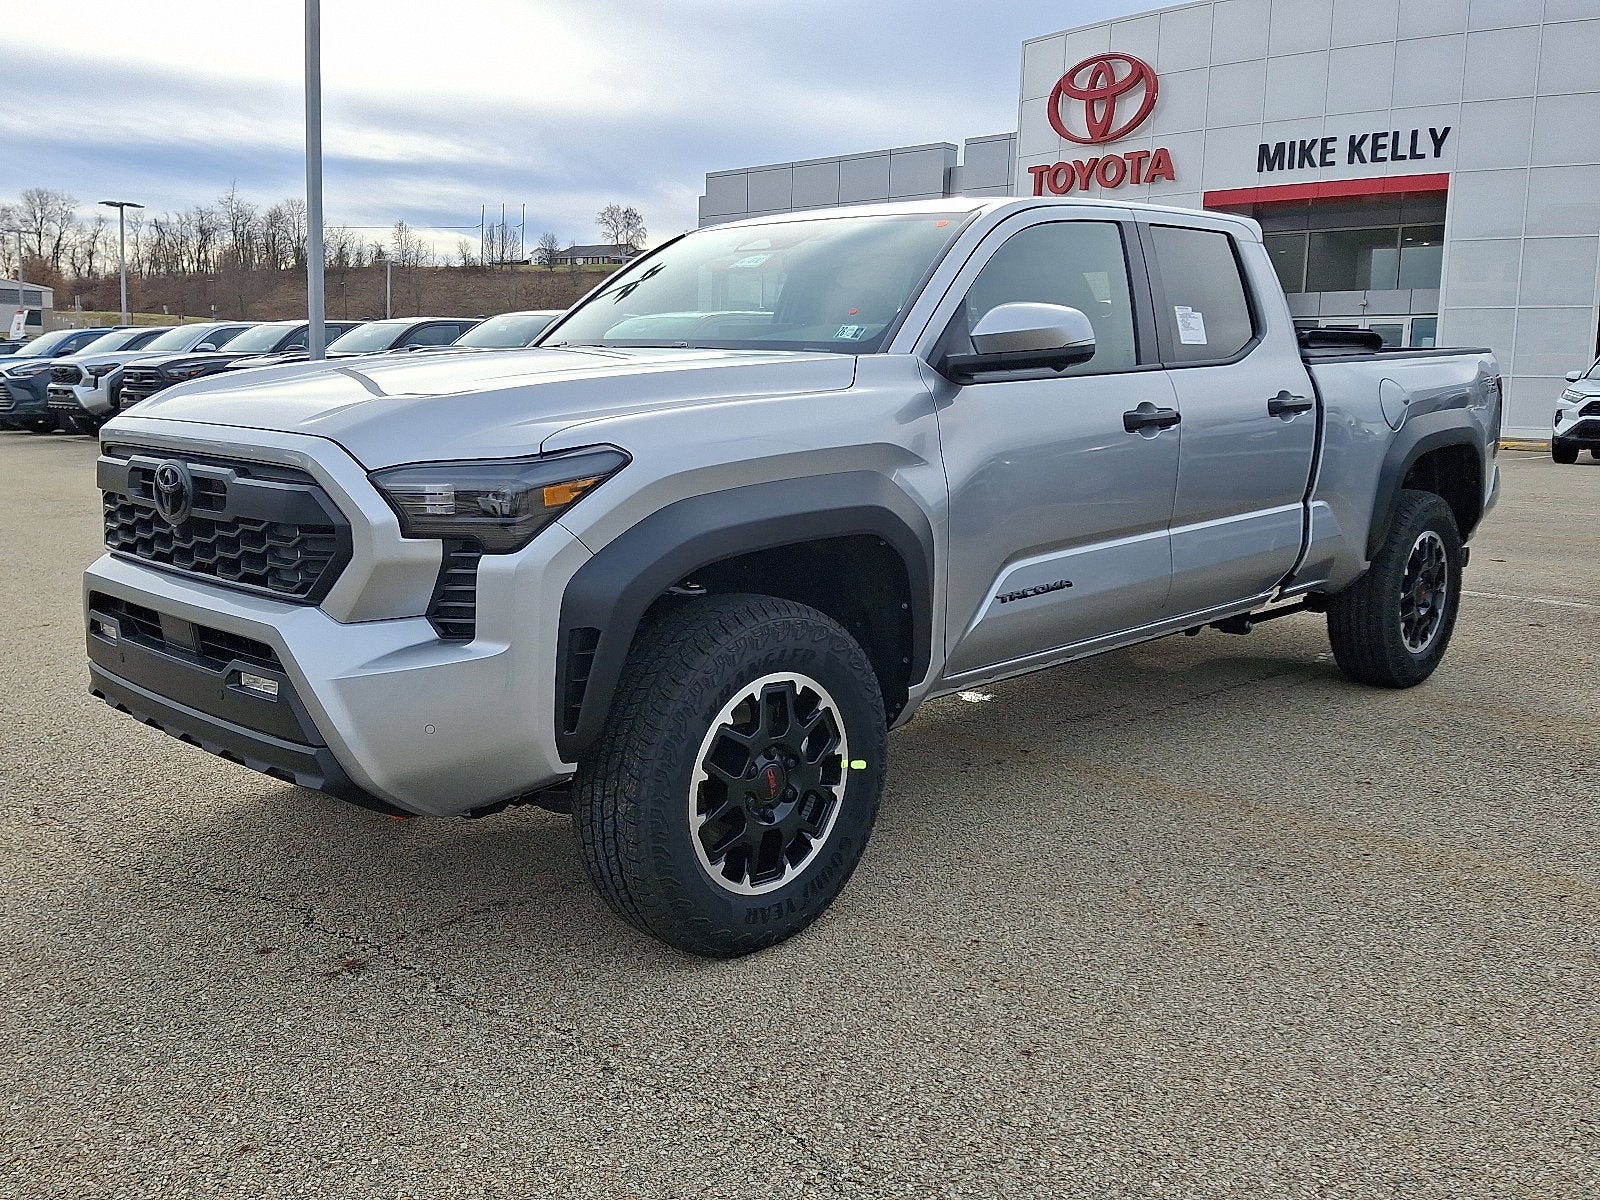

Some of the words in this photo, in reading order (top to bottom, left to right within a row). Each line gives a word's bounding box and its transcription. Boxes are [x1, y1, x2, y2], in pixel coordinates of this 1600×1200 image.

[1028, 147, 1176, 197] TOYOTA
[1256, 136, 1338, 173] MIKE
[1346, 126, 1452, 166] KELLY
[995, 579, 1074, 604] TACOMA
